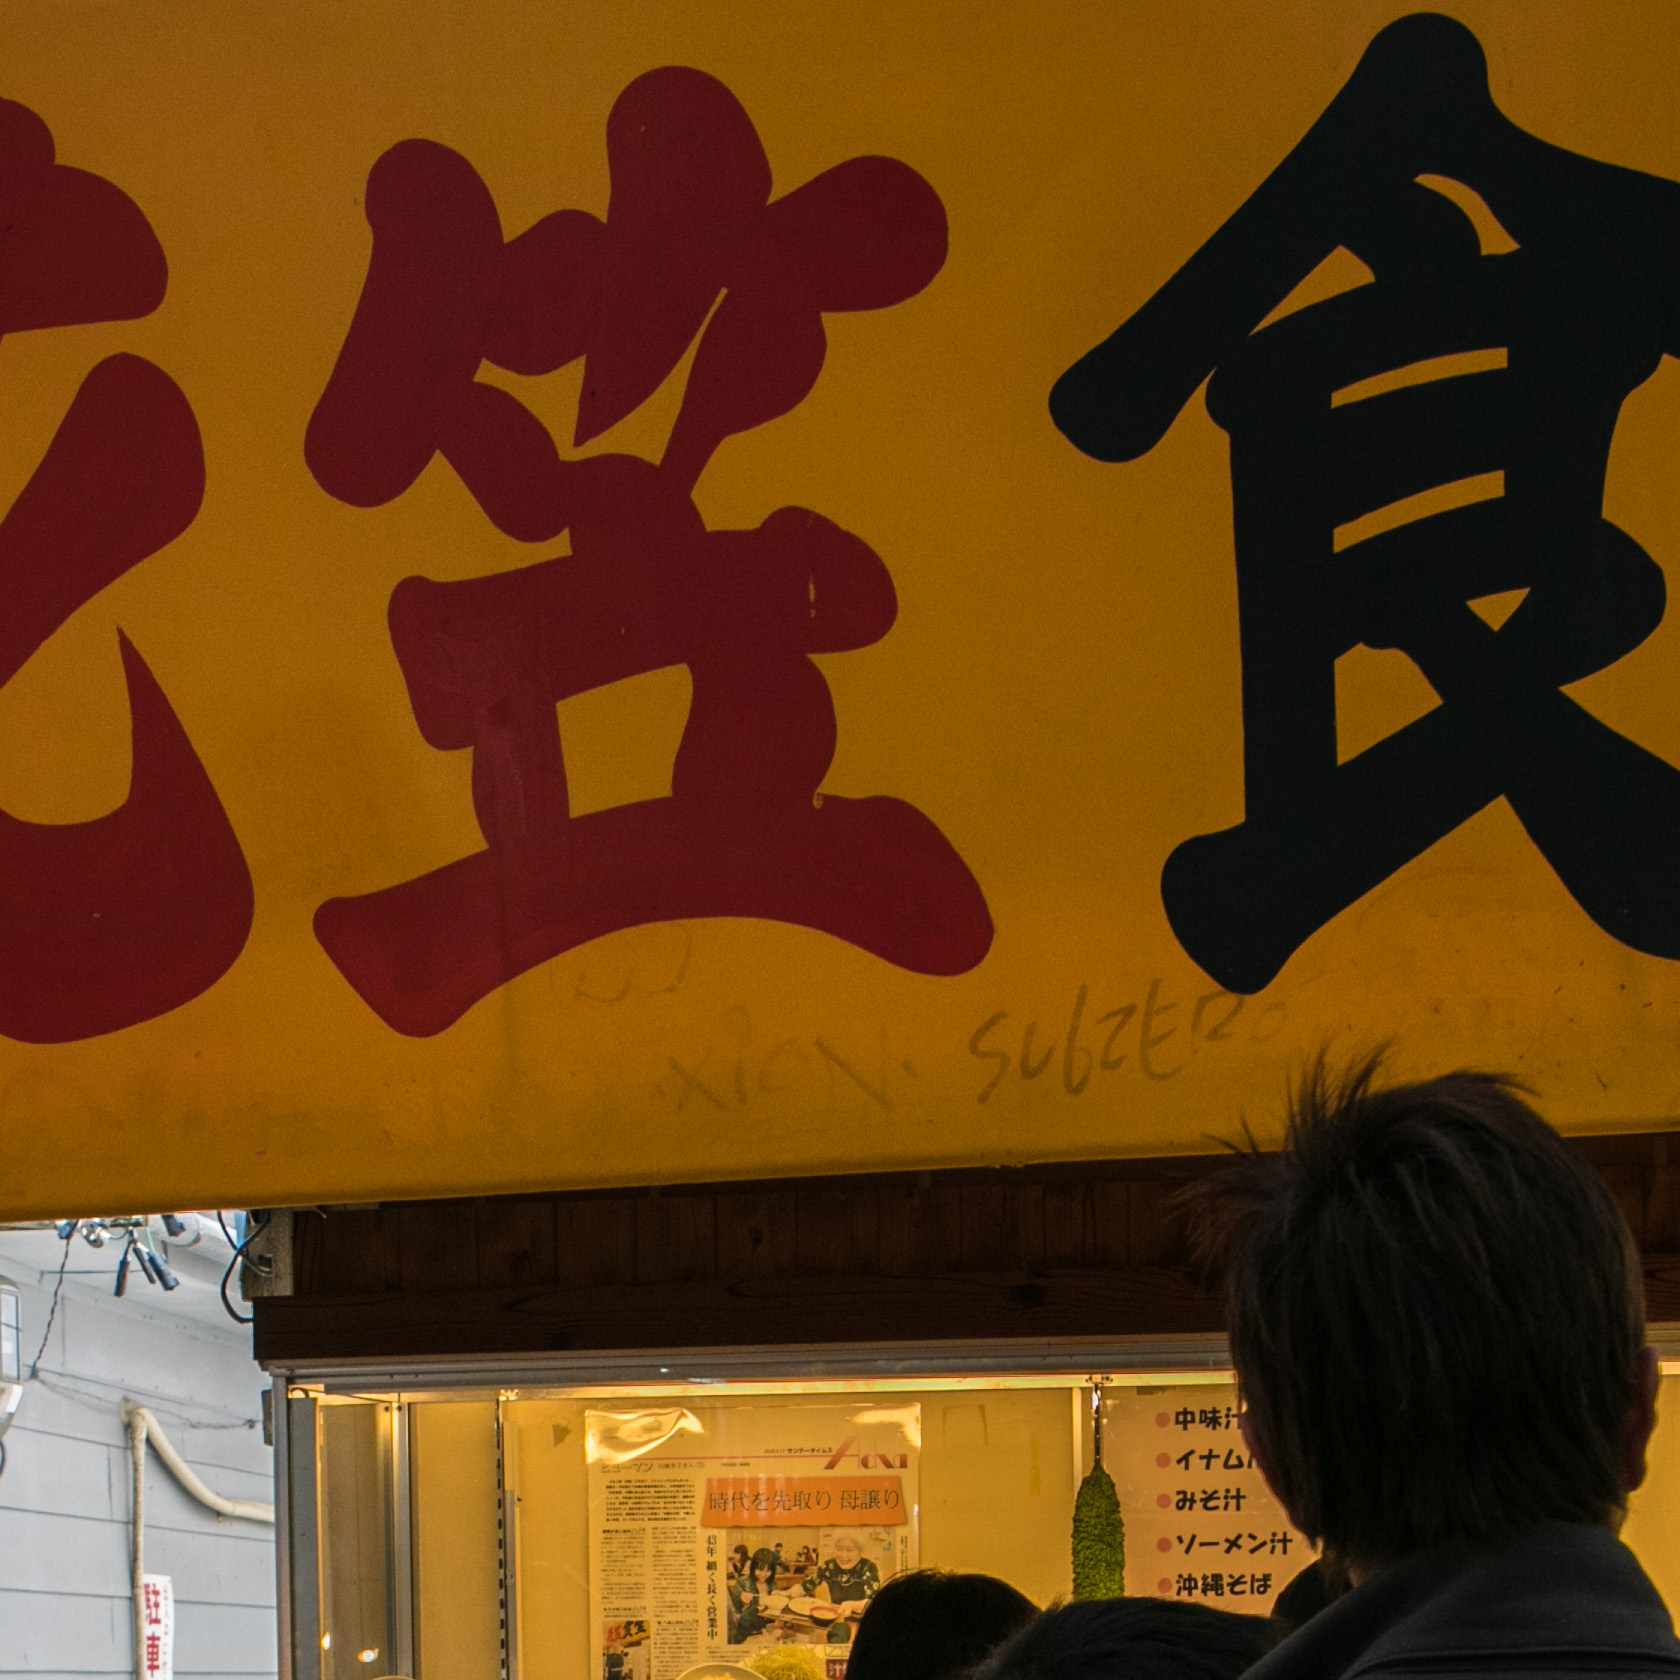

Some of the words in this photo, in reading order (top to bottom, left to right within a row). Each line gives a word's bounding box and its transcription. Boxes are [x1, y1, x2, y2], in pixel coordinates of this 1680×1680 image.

[708, 1489, 831, 1512] 時代を先取り
[839, 1489, 900, 1510] 母譲り
[1175, 1488, 1246, 1511] みそ汁
[1176, 1532, 1293, 1555] ソーメン汁
[1176, 1573, 1273, 1596] 沖縄そば
